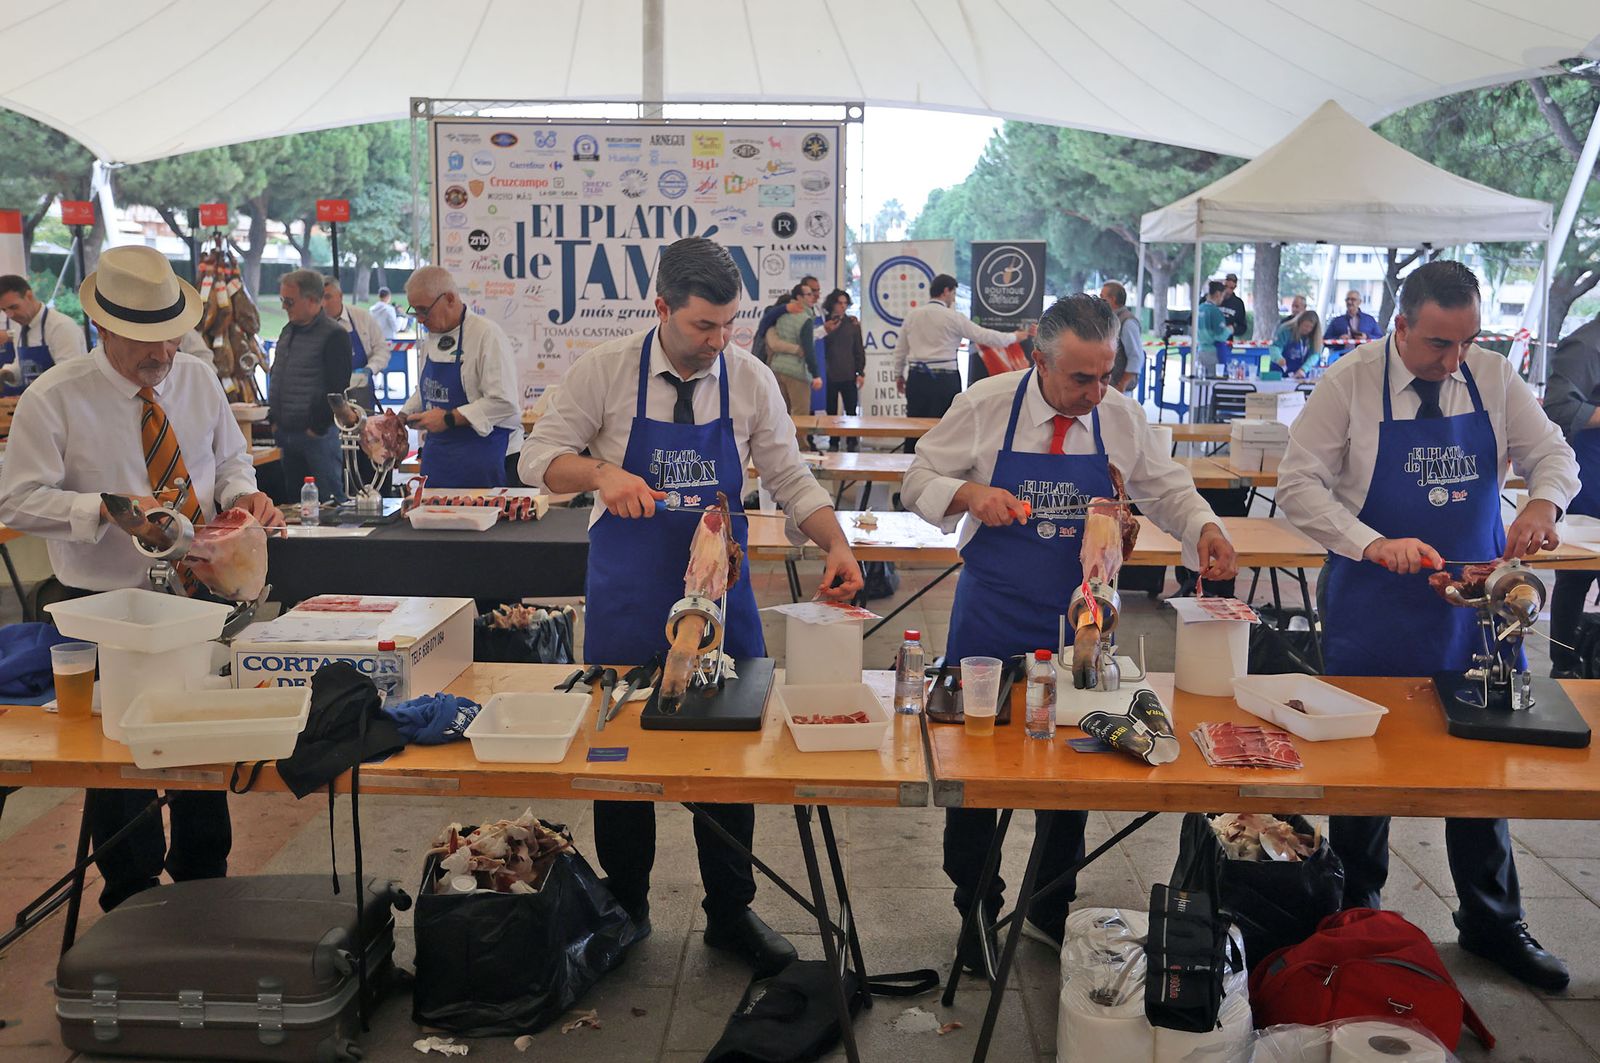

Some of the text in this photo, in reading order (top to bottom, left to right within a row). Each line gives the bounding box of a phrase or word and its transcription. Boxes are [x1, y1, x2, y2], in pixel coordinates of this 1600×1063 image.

[509, 161, 545, 169] Carrefour
[490, 177, 548, 189] Cruzcampo
[580, 204, 697, 239] PLATO
[504, 221, 763, 325] de JAMN
[984, 287, 1025, 295] BOUTIQUE
[580, 305, 614, 319] más
[617, 307, 661, 321] gran
[543, 325, 634, 337] TOMÁS CASTAÑO
